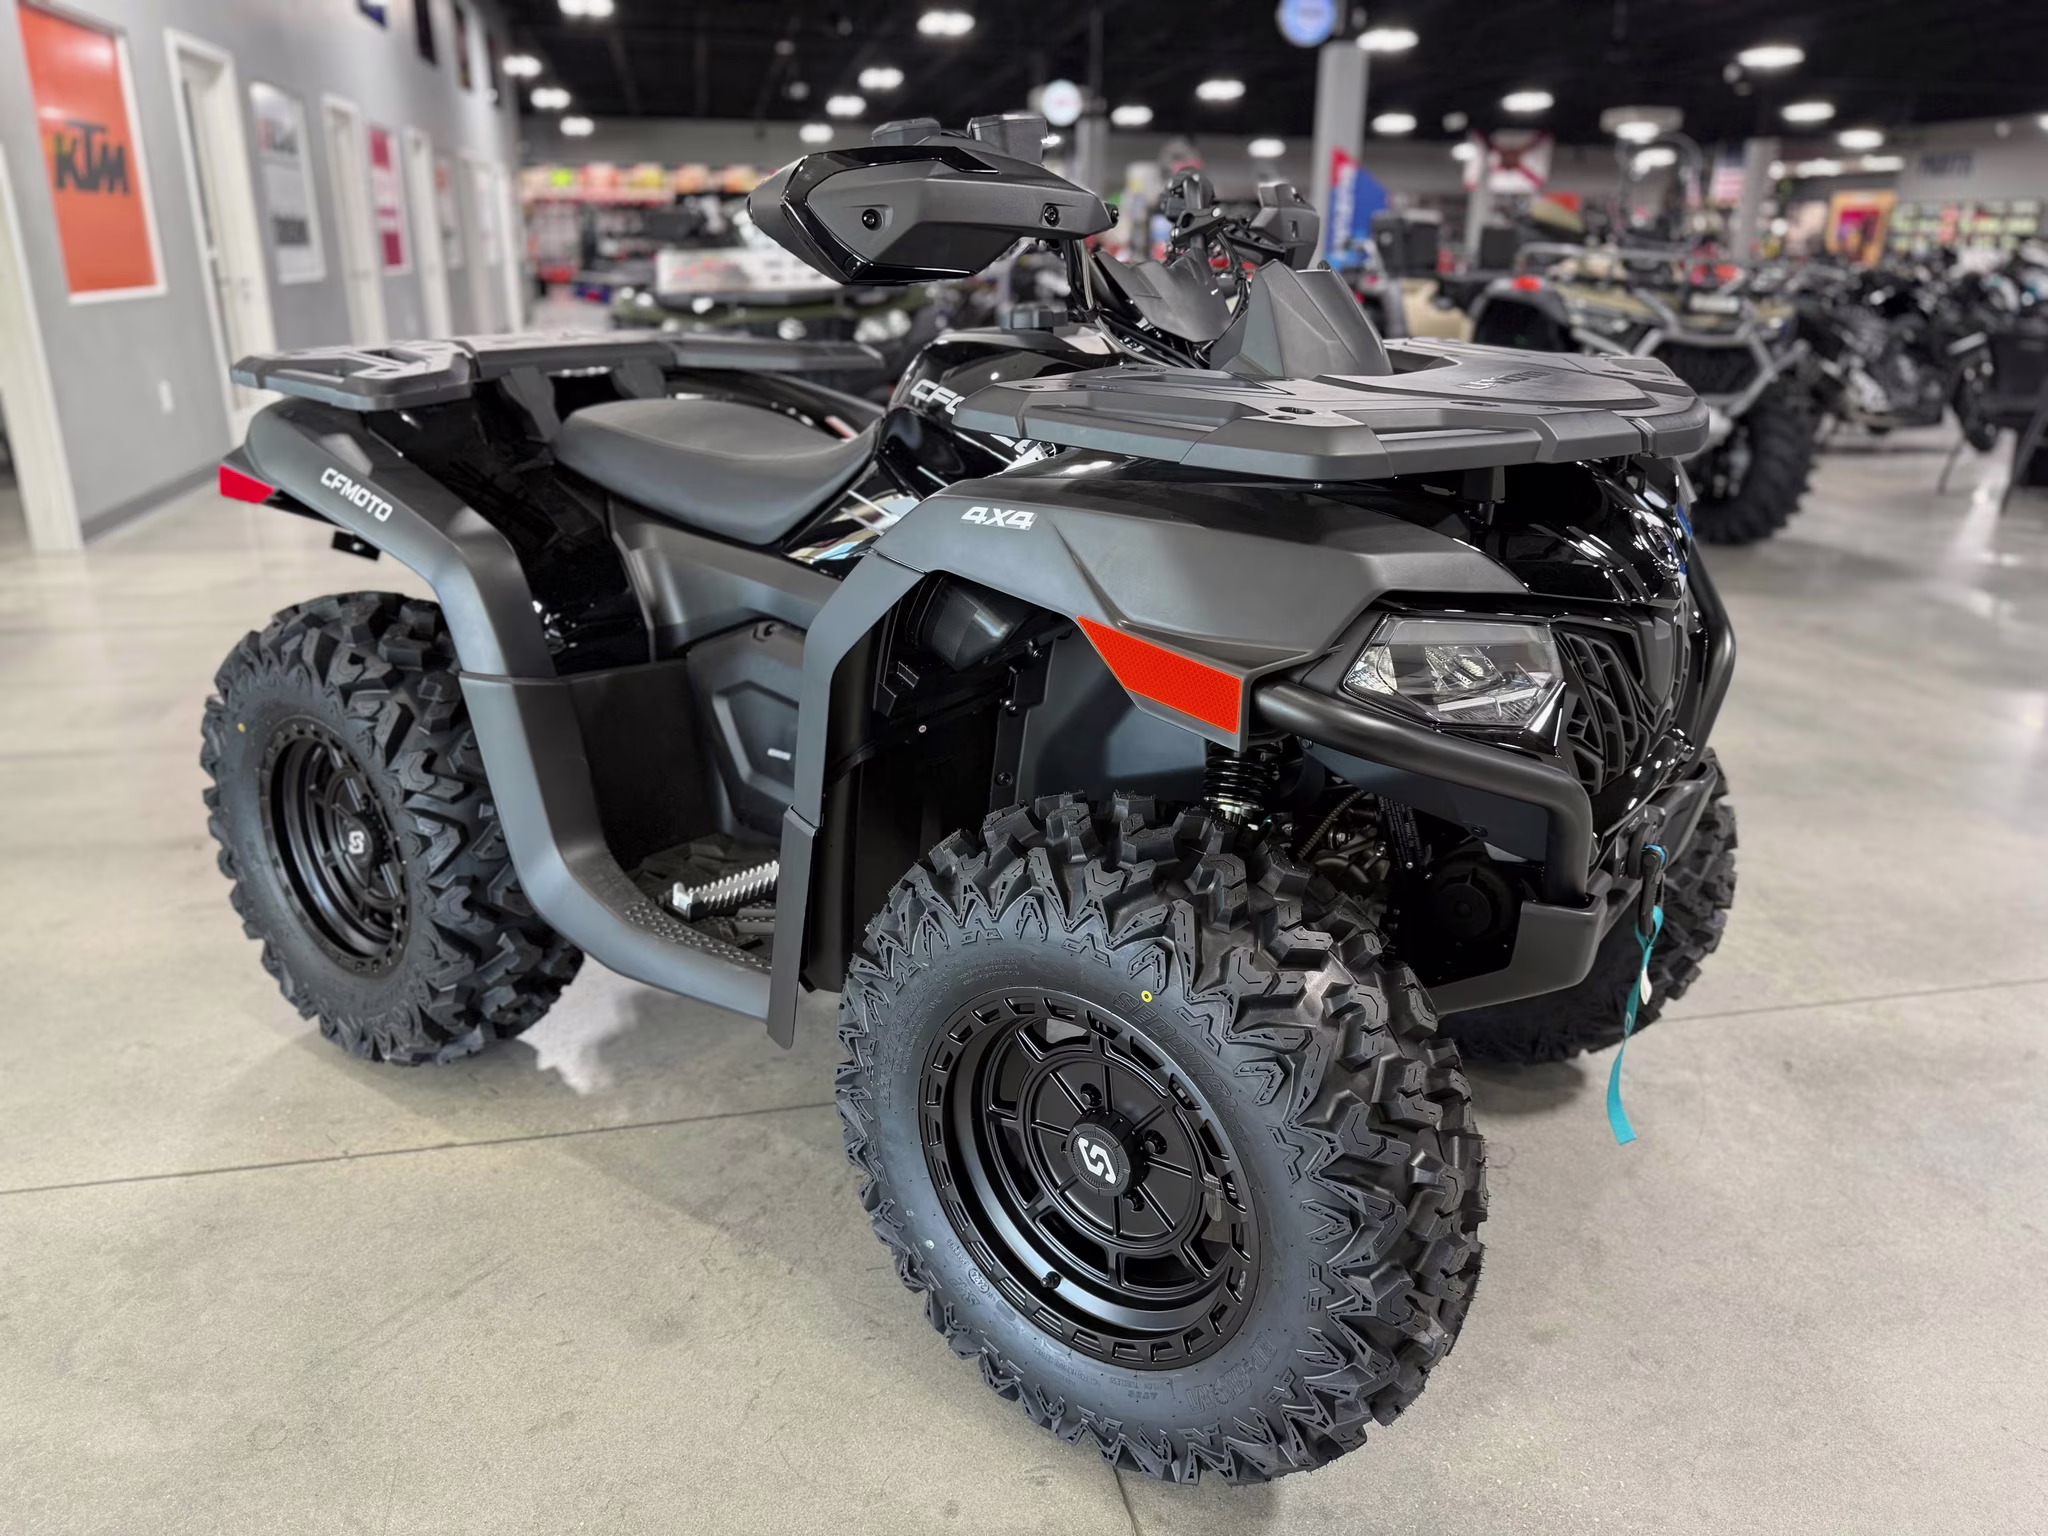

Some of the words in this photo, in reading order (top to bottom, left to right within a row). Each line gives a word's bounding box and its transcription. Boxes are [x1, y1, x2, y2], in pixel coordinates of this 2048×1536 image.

[55, 121, 131, 197] KTM
[320, 466, 393, 523] CFMOTO
[962, 506, 1036, 531] 4X4
[1113, 989, 1233, 1102] SEDONA
[971, 1271, 988, 1290] 2424
